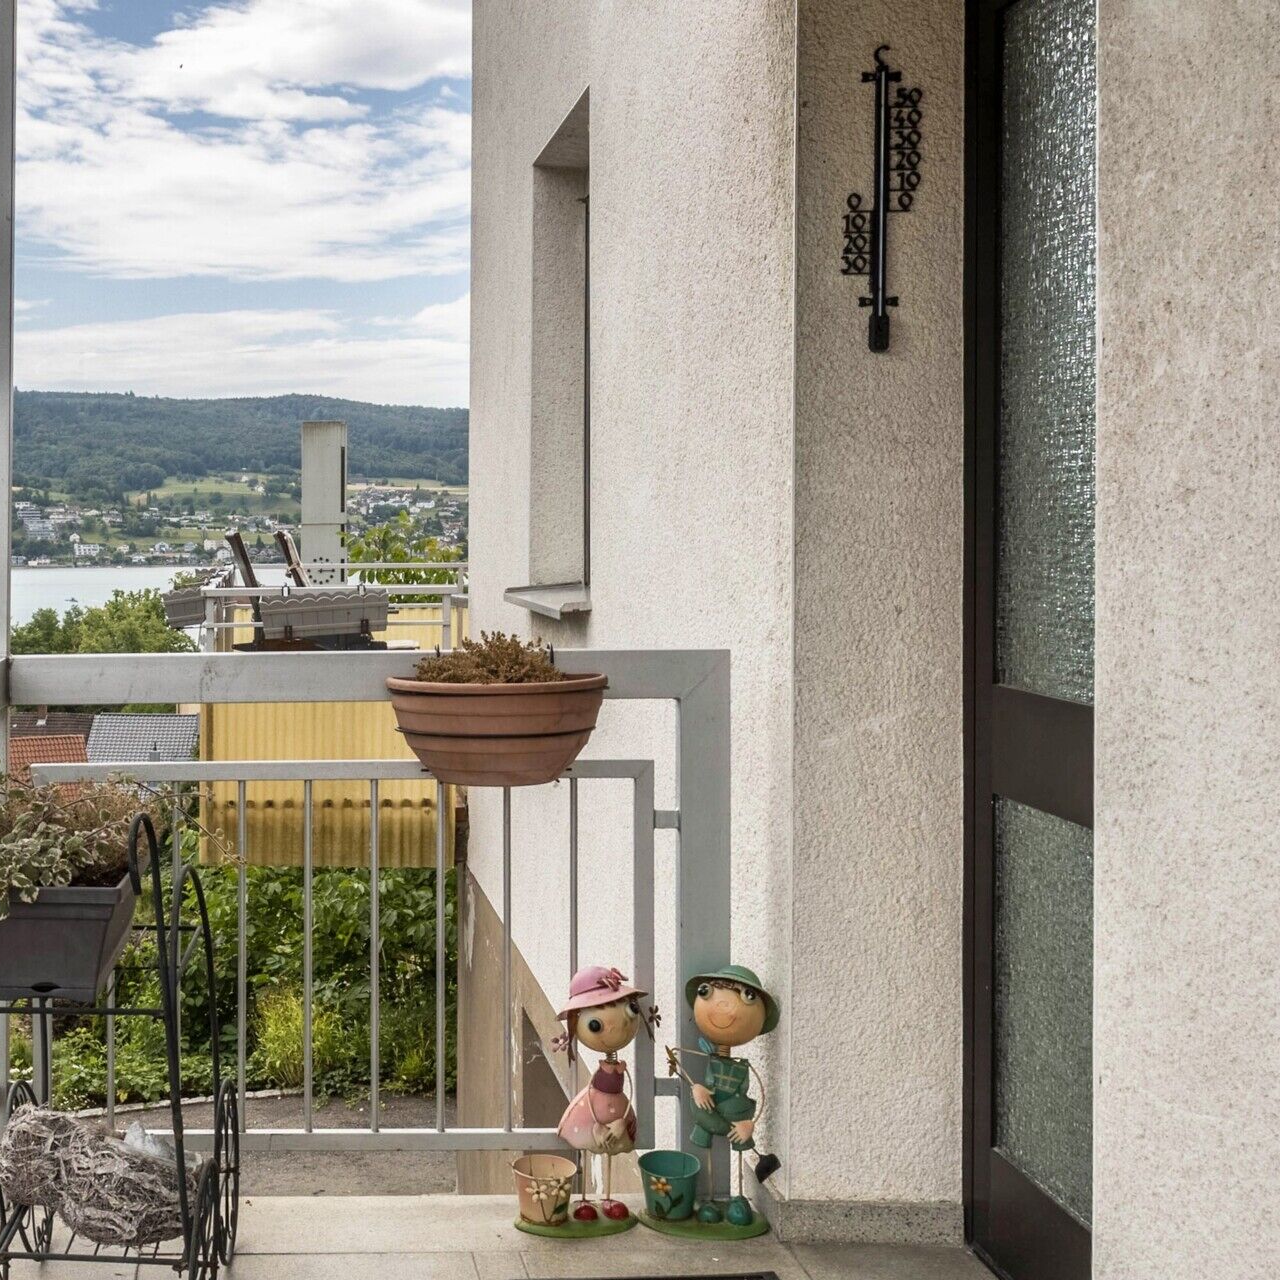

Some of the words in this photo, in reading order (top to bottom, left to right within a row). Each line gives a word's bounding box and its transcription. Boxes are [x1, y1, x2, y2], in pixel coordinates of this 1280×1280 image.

[896, 87, 923, 107] 50
[893, 108, 922, 128] 40
[895, 129, 922, 149] 30
[896, 150, 921, 169] 20
[897, 171, 921, 190] 10
[847, 192, 862, 210] 0
[898, 191, 914, 210] 0
[842, 213, 866, 232] 10
[843, 234, 867, 253] 20
[841, 255, 867, 274] 30
